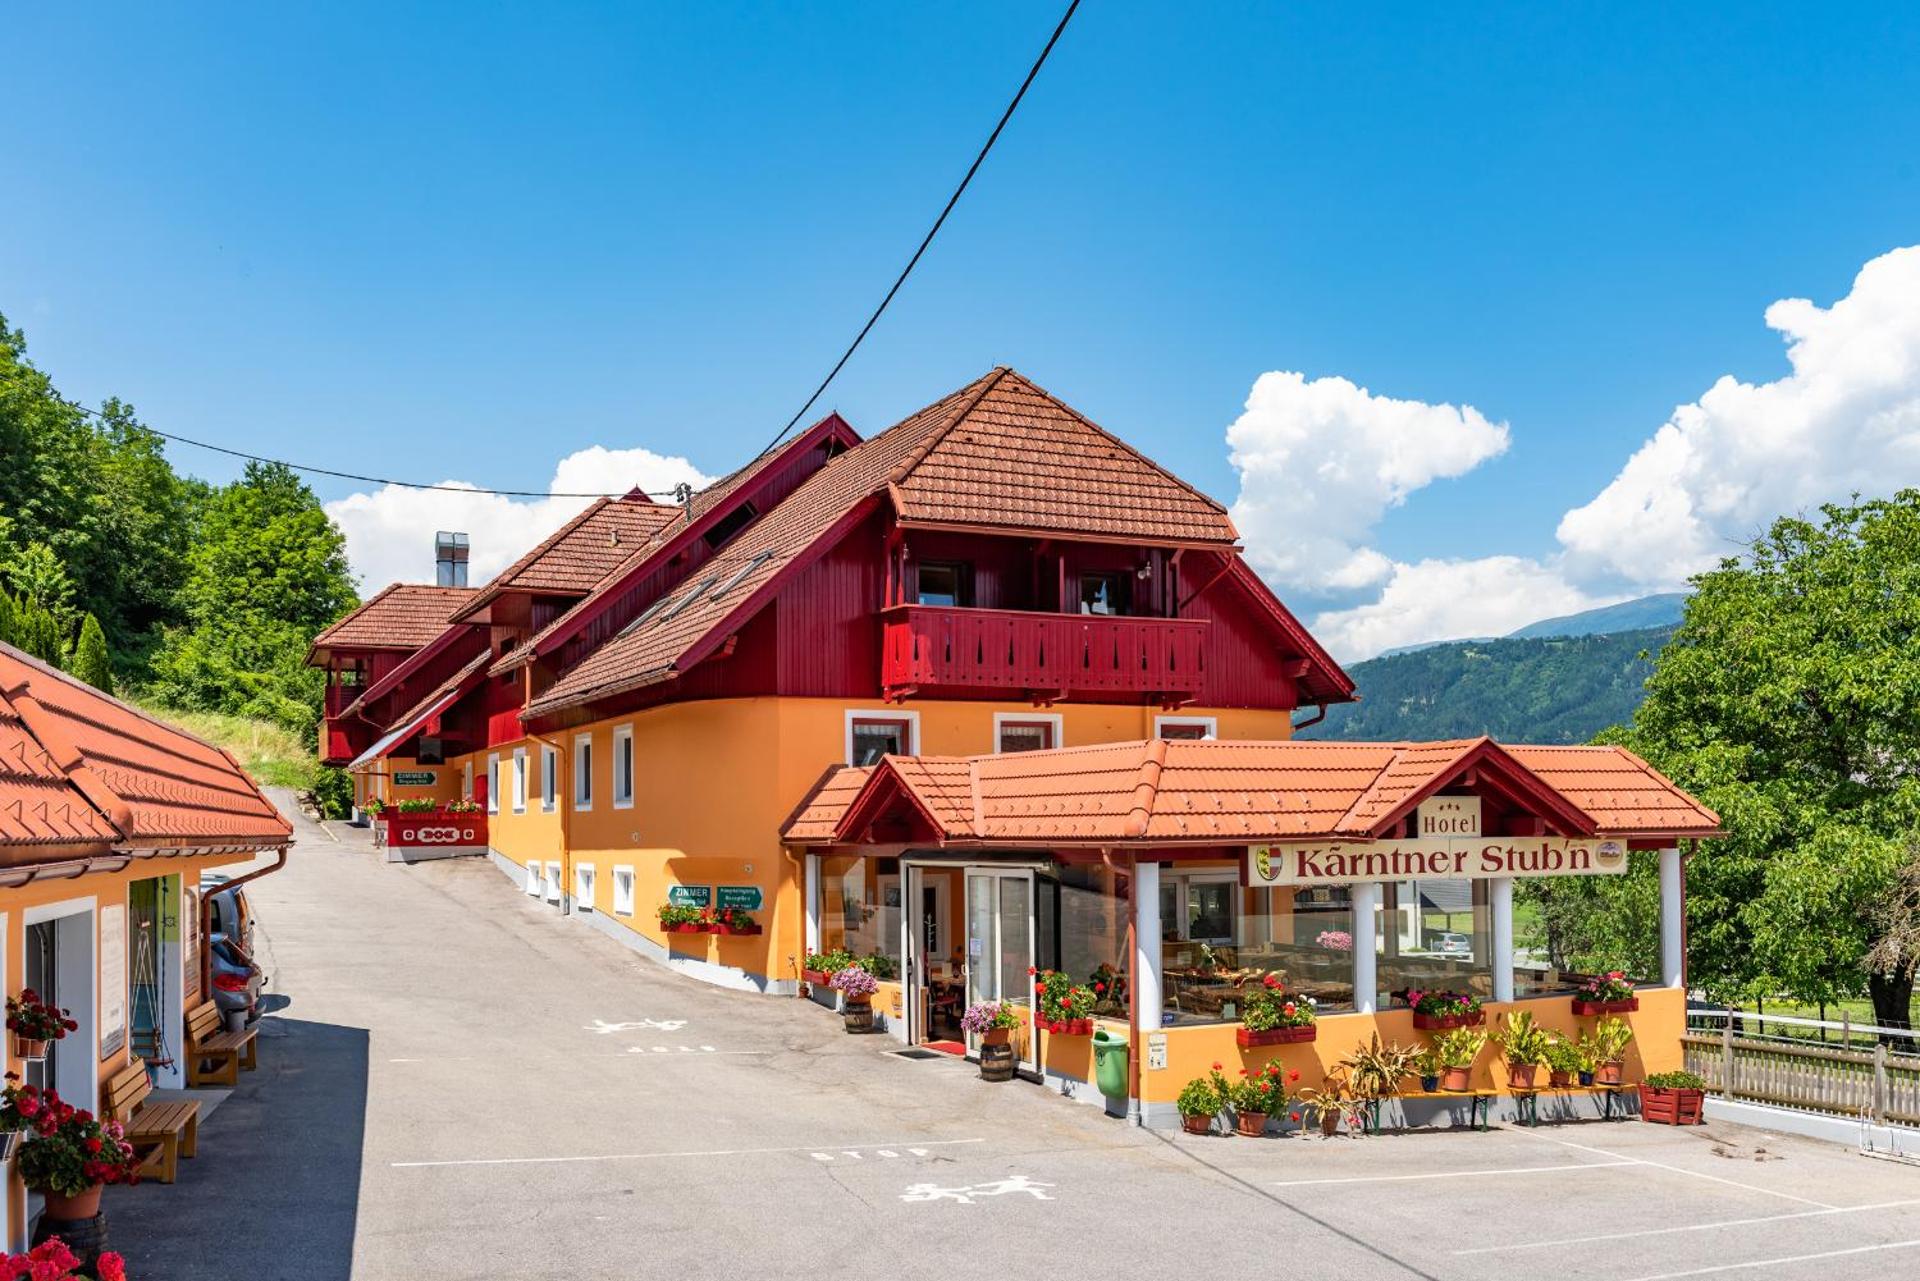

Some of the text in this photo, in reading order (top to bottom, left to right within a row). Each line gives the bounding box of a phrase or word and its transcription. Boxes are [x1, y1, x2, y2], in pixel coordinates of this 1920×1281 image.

[1424, 814, 1476, 833] Hotel
[1480, 839, 1592, 873] Stub'n
[675, 887, 708, 897] ZIMMER
[809, 1147, 929, 1161] STOP
